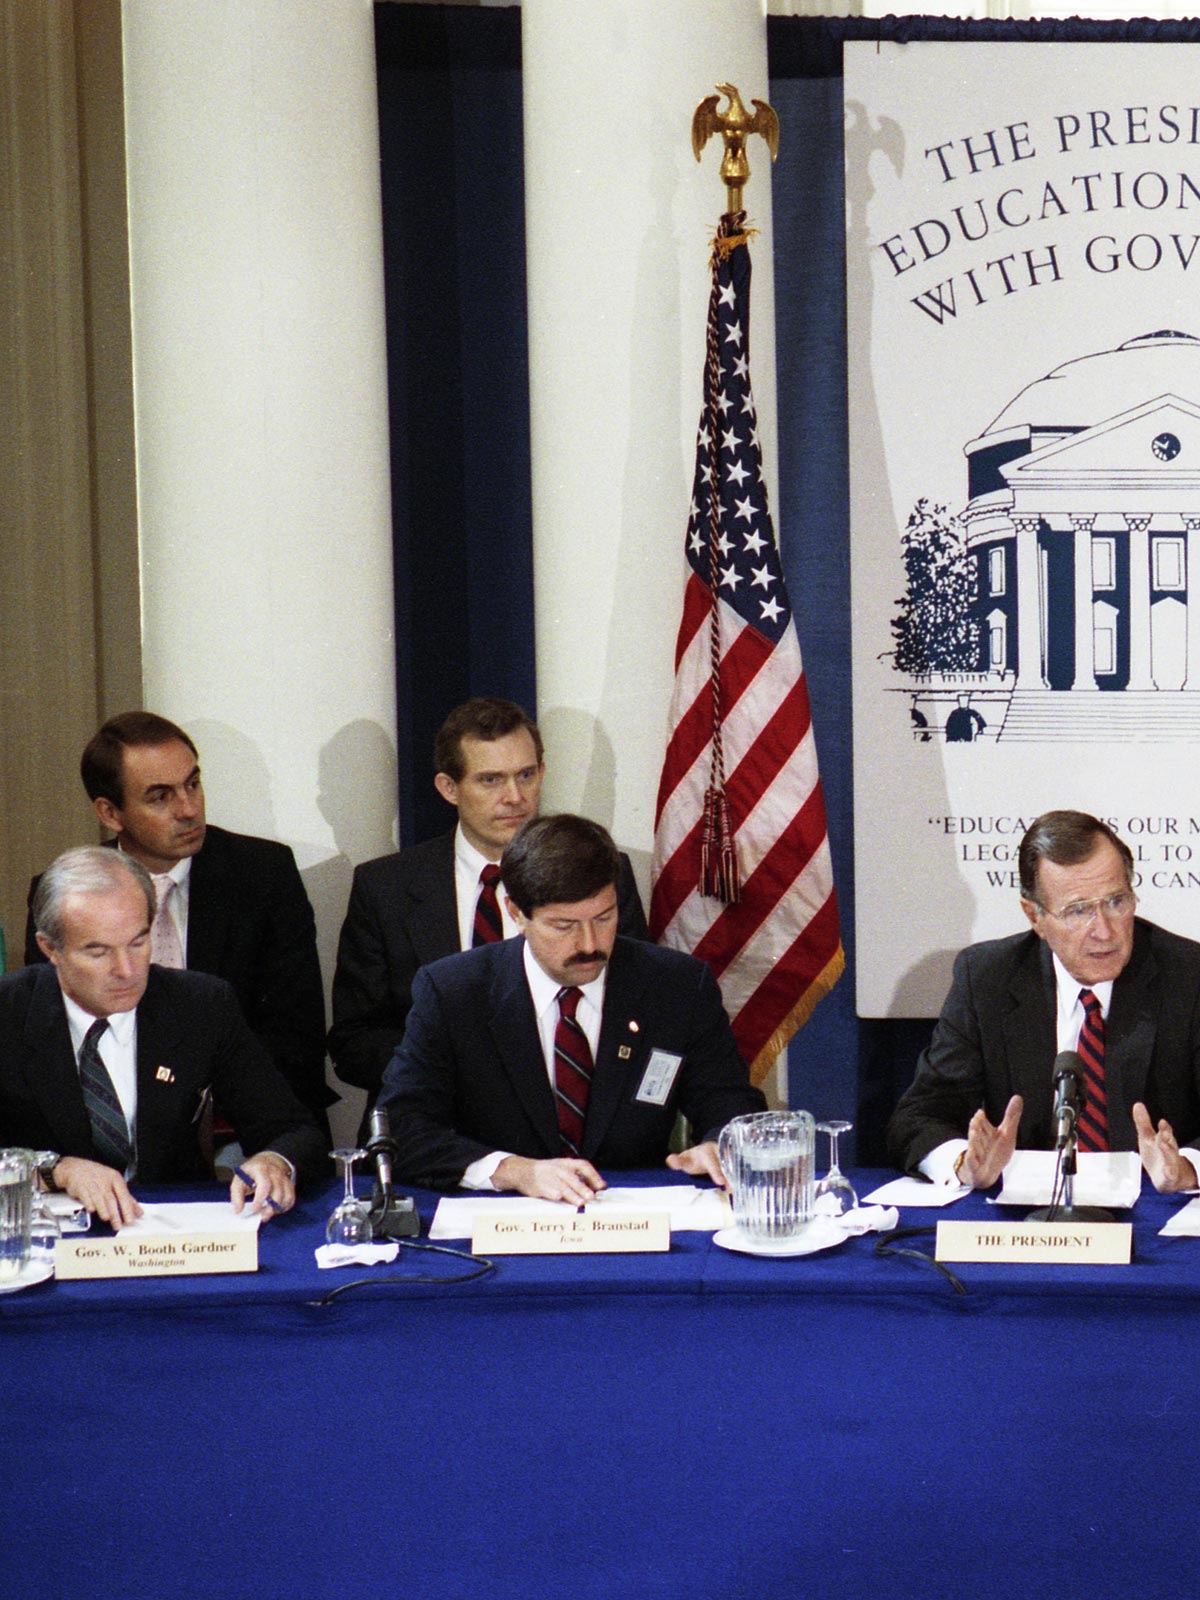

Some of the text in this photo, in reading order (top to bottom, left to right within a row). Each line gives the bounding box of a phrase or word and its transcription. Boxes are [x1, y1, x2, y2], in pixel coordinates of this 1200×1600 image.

[925, 121, 1037, 184] THE
[910, 245, 1063, 326] WITH
[1100, 816, 1119, 833] S
[1127, 816, 1178, 834] OUR
[1160, 844, 1193, 862] TO
[986, 871, 1020, 888] WE
[494, 1222, 525, 1233] Gov.
[531, 1221, 565, 1234] Terry
[592, 1220, 649, 1232] Branstad
[976, 1235, 1093, 1247] THE PRESIDENT
[75, 1242, 237, 1258] Gov. W. Booth Gardner
[128, 1258, 186, 1268] Washington
